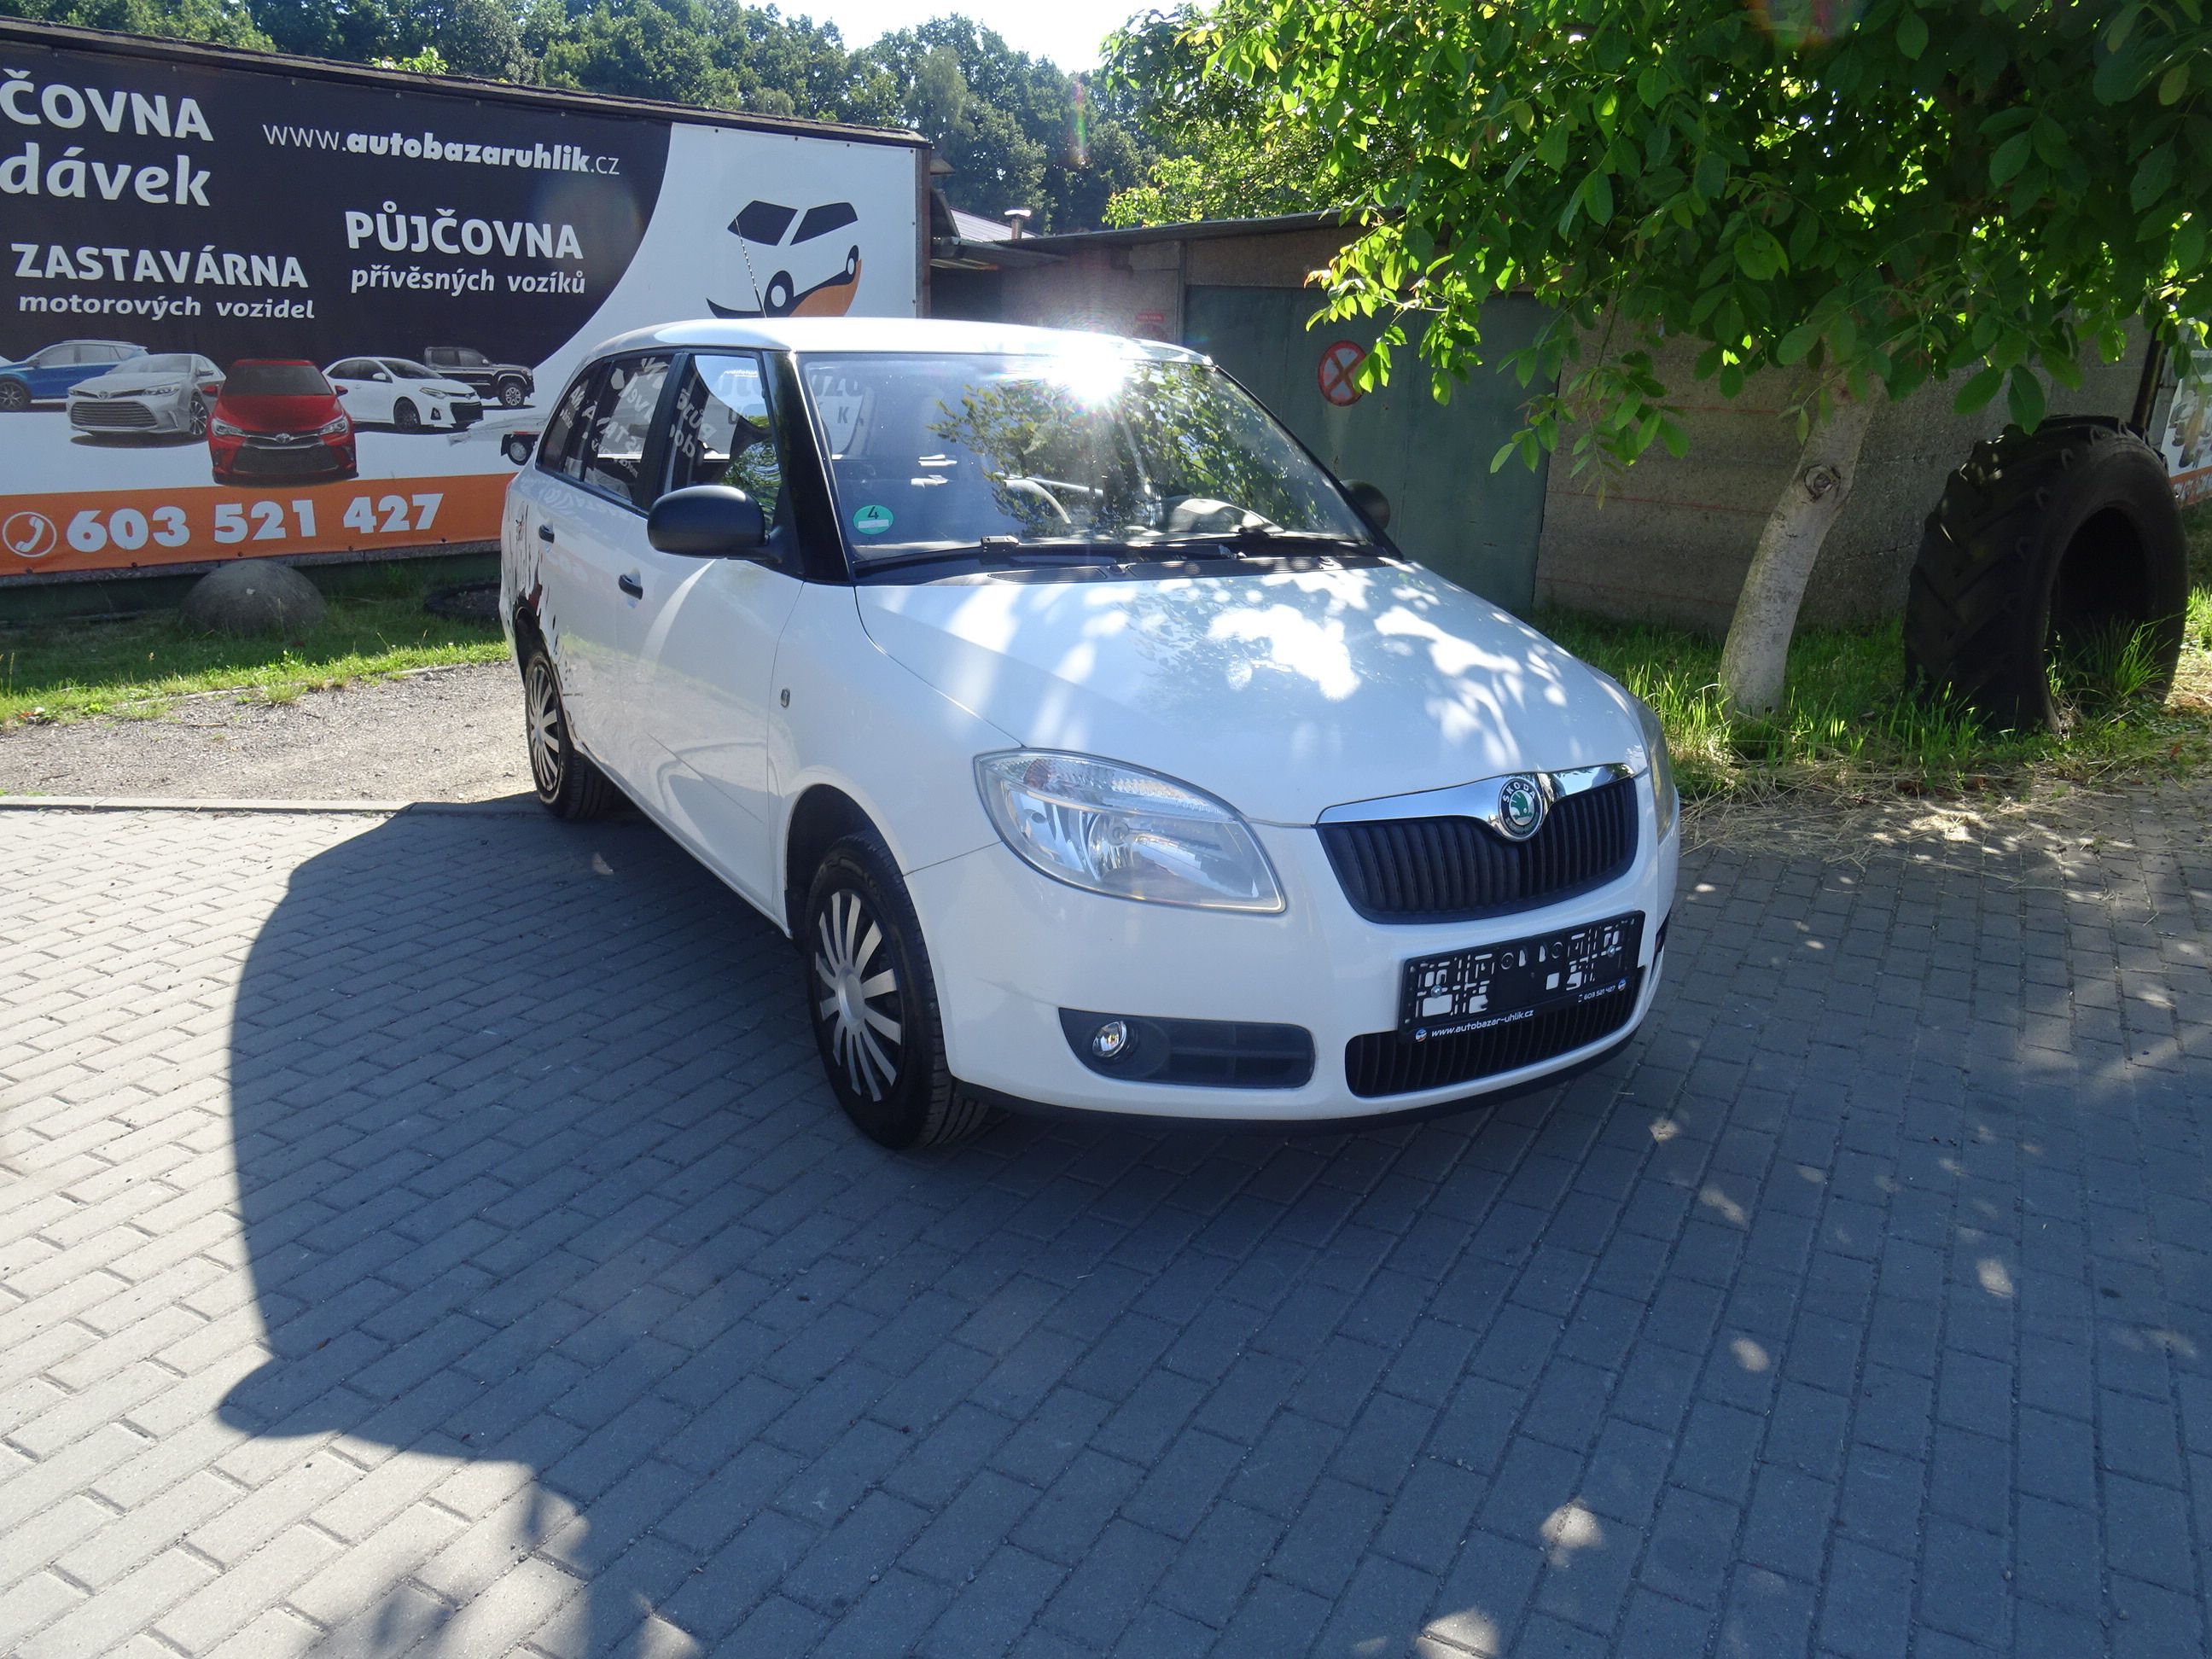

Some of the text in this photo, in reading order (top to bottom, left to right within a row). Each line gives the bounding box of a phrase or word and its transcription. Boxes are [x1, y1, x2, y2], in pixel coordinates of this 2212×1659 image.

[0, 68, 213, 141] ČOVNA
[0, 142, 211, 207] dávek
[262, 124, 620, 175] www.autobazaruhlik.cz
[345, 201, 584, 259] PŮJČOVNA
[11, 245, 308, 288] ZASTAVÁRNA
[351, 265, 585, 296] přívěsných vozíků
[19, 294, 315, 320] motorových vozidel
[67, 492, 444, 552] 603 521 427
[1431, 1010, 1534, 1037] www.autobazar-uhlik.cz
